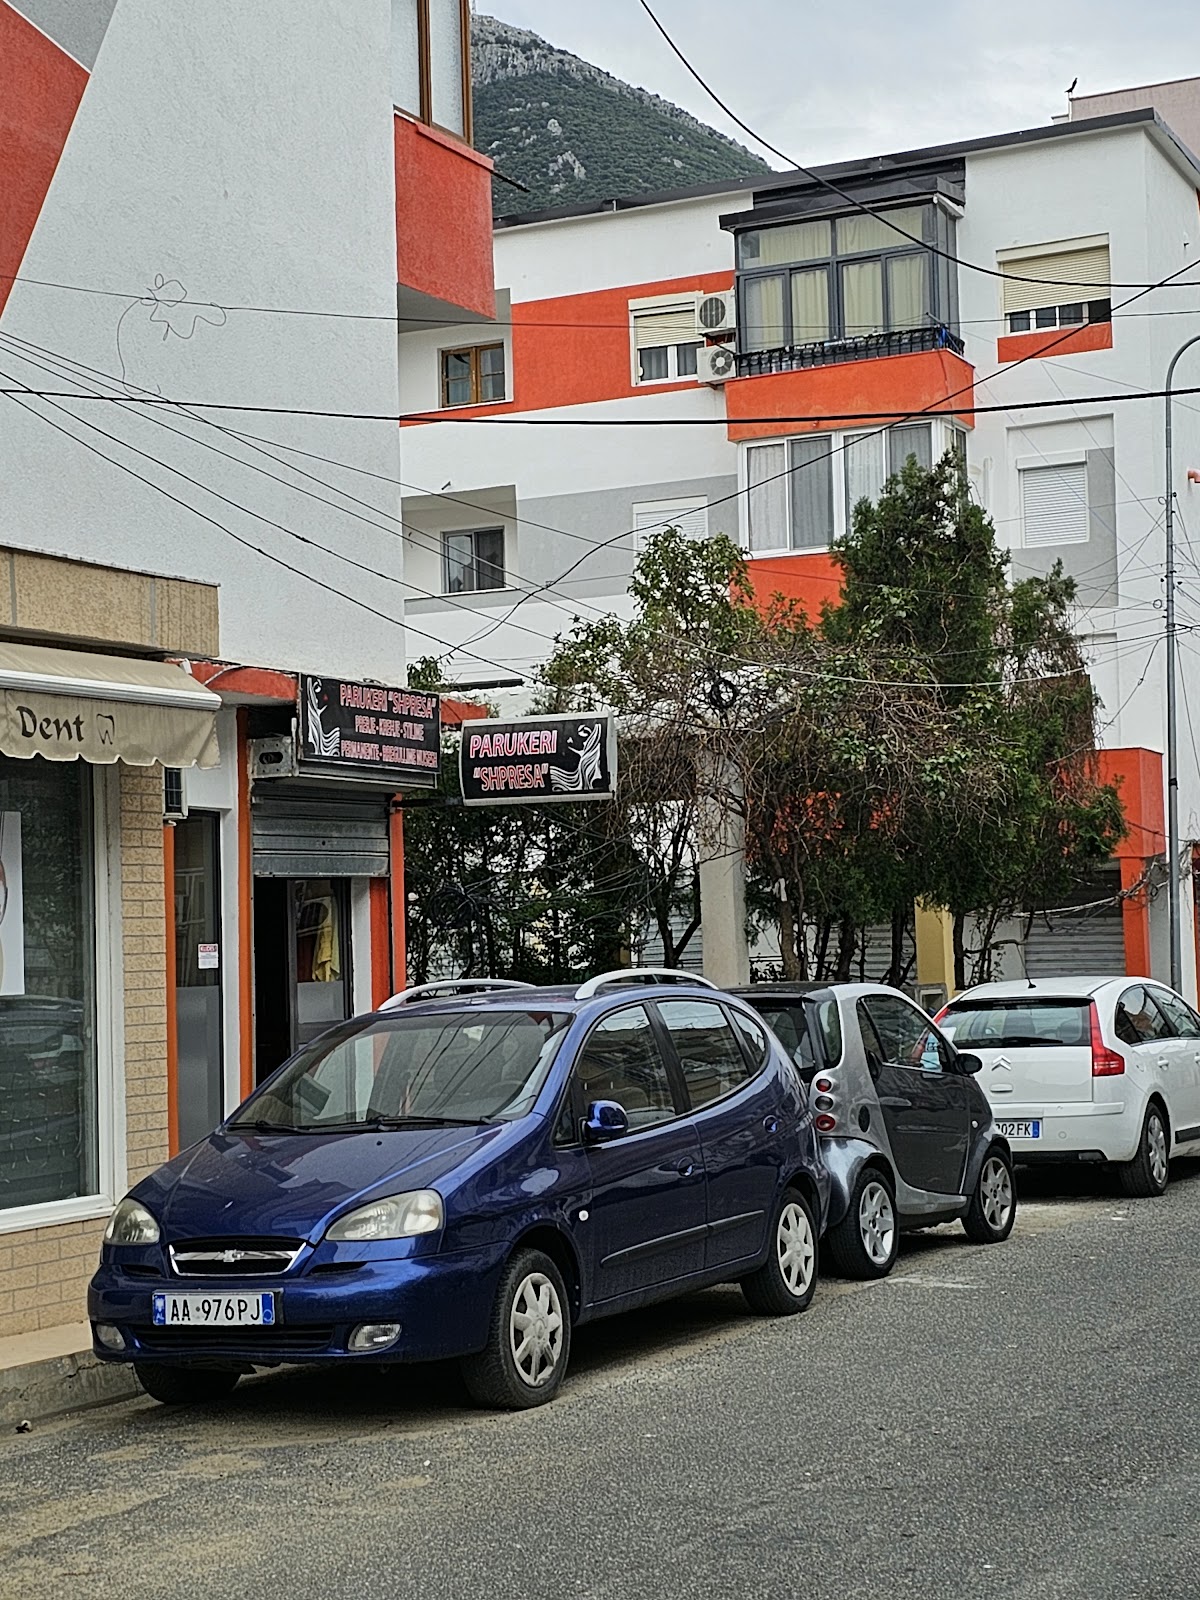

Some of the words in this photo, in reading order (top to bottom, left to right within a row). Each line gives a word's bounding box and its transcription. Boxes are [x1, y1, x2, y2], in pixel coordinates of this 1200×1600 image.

[339, 684, 388, 712] PARUKERI
[16, 705, 85, 743] Dent
[469, 729, 558, 759] PARUKERI
[171, 1299, 191, 1321] AA
[201, 1298, 260, 1322] 976PJ
